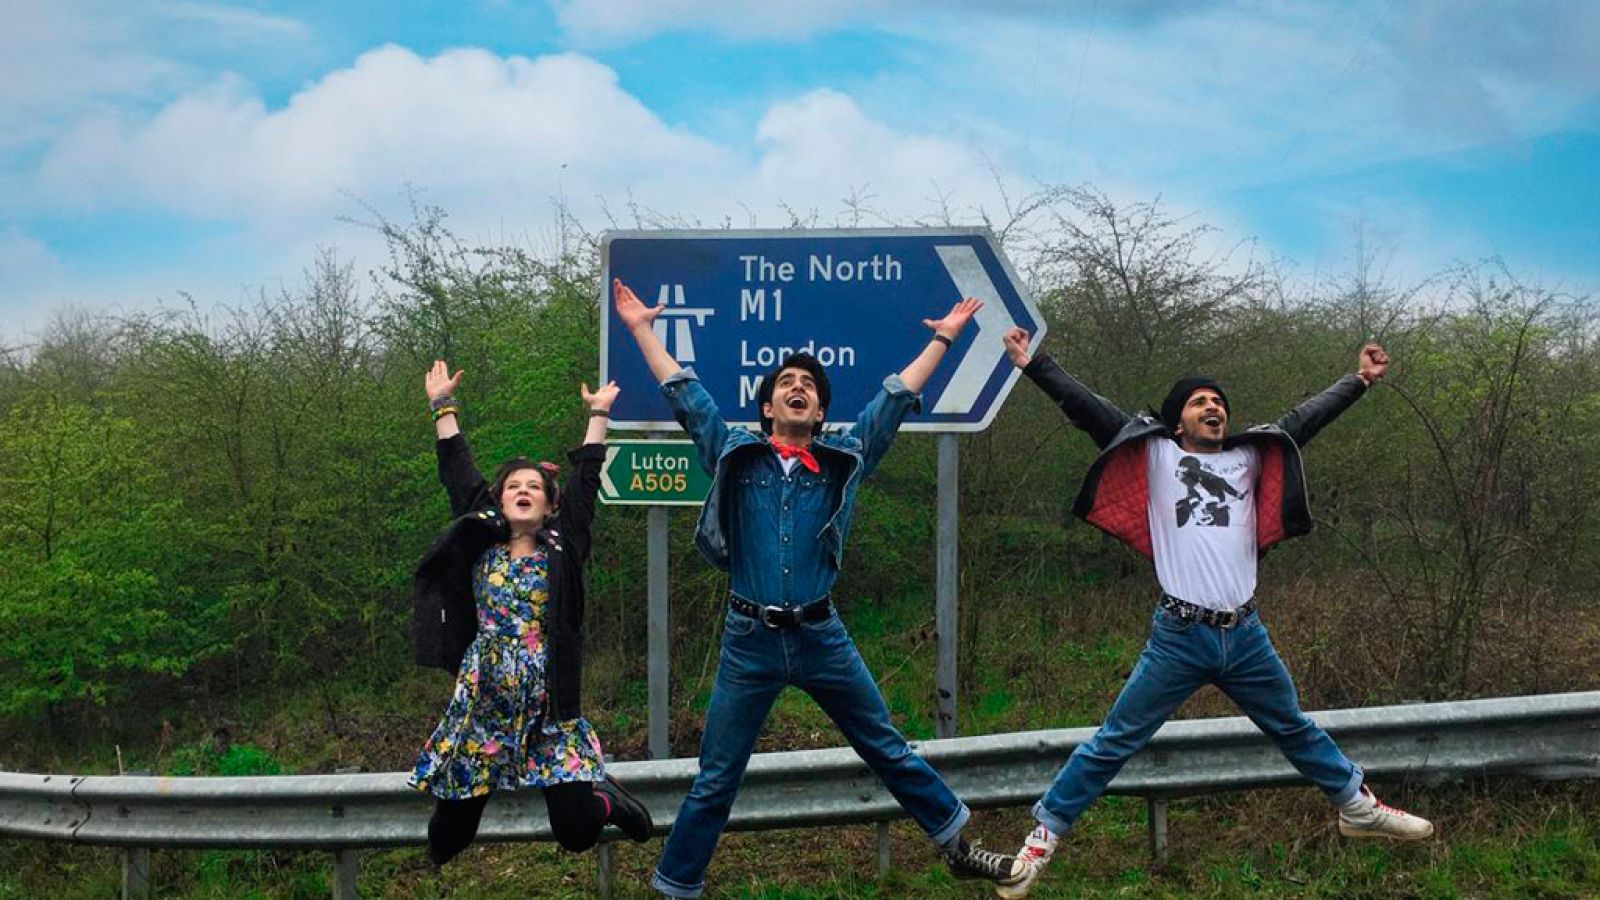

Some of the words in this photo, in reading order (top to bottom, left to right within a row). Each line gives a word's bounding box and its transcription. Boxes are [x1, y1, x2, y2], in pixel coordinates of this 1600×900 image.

[739, 255, 795, 282] The
[808, 254, 903, 281] North
[740, 288, 782, 321] M1
[739, 375, 765, 408] M
[631, 452, 689, 470] Luton
[630, 473, 687, 492] A505
